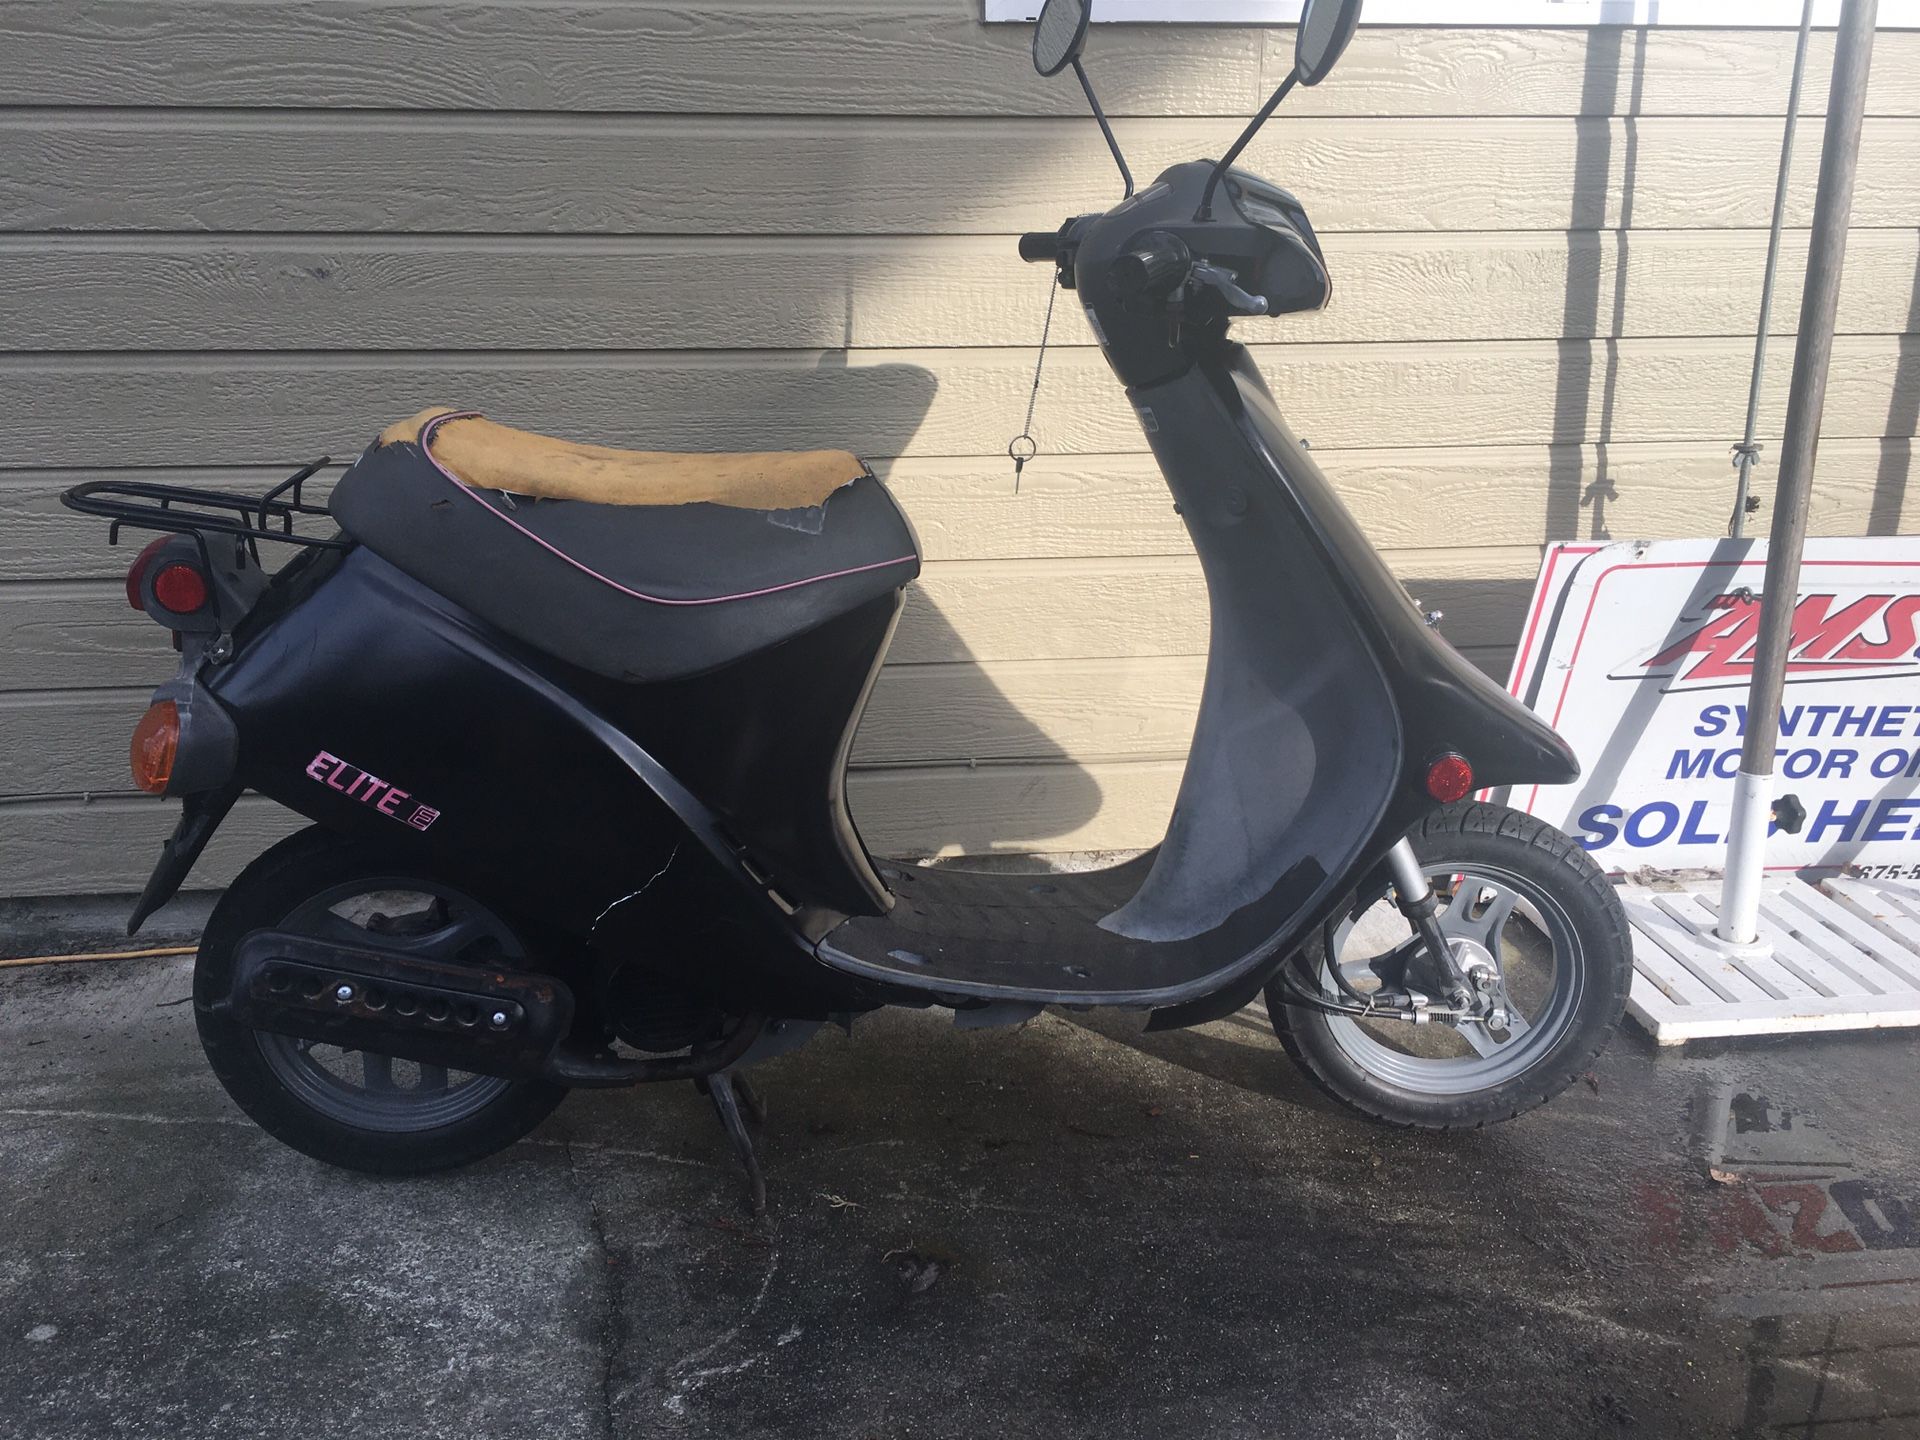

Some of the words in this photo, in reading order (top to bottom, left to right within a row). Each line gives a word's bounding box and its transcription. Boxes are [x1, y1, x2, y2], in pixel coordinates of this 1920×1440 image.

[1640, 594, 1920, 680] AMS
[1693, 704, 1920, 737] SNTHE
[306, 750, 410, 815] ELITE
[1870, 748, 1920, 778] OI
[1572, 800, 1776, 850] SOL
[1805, 799, 1920, 842] HE
